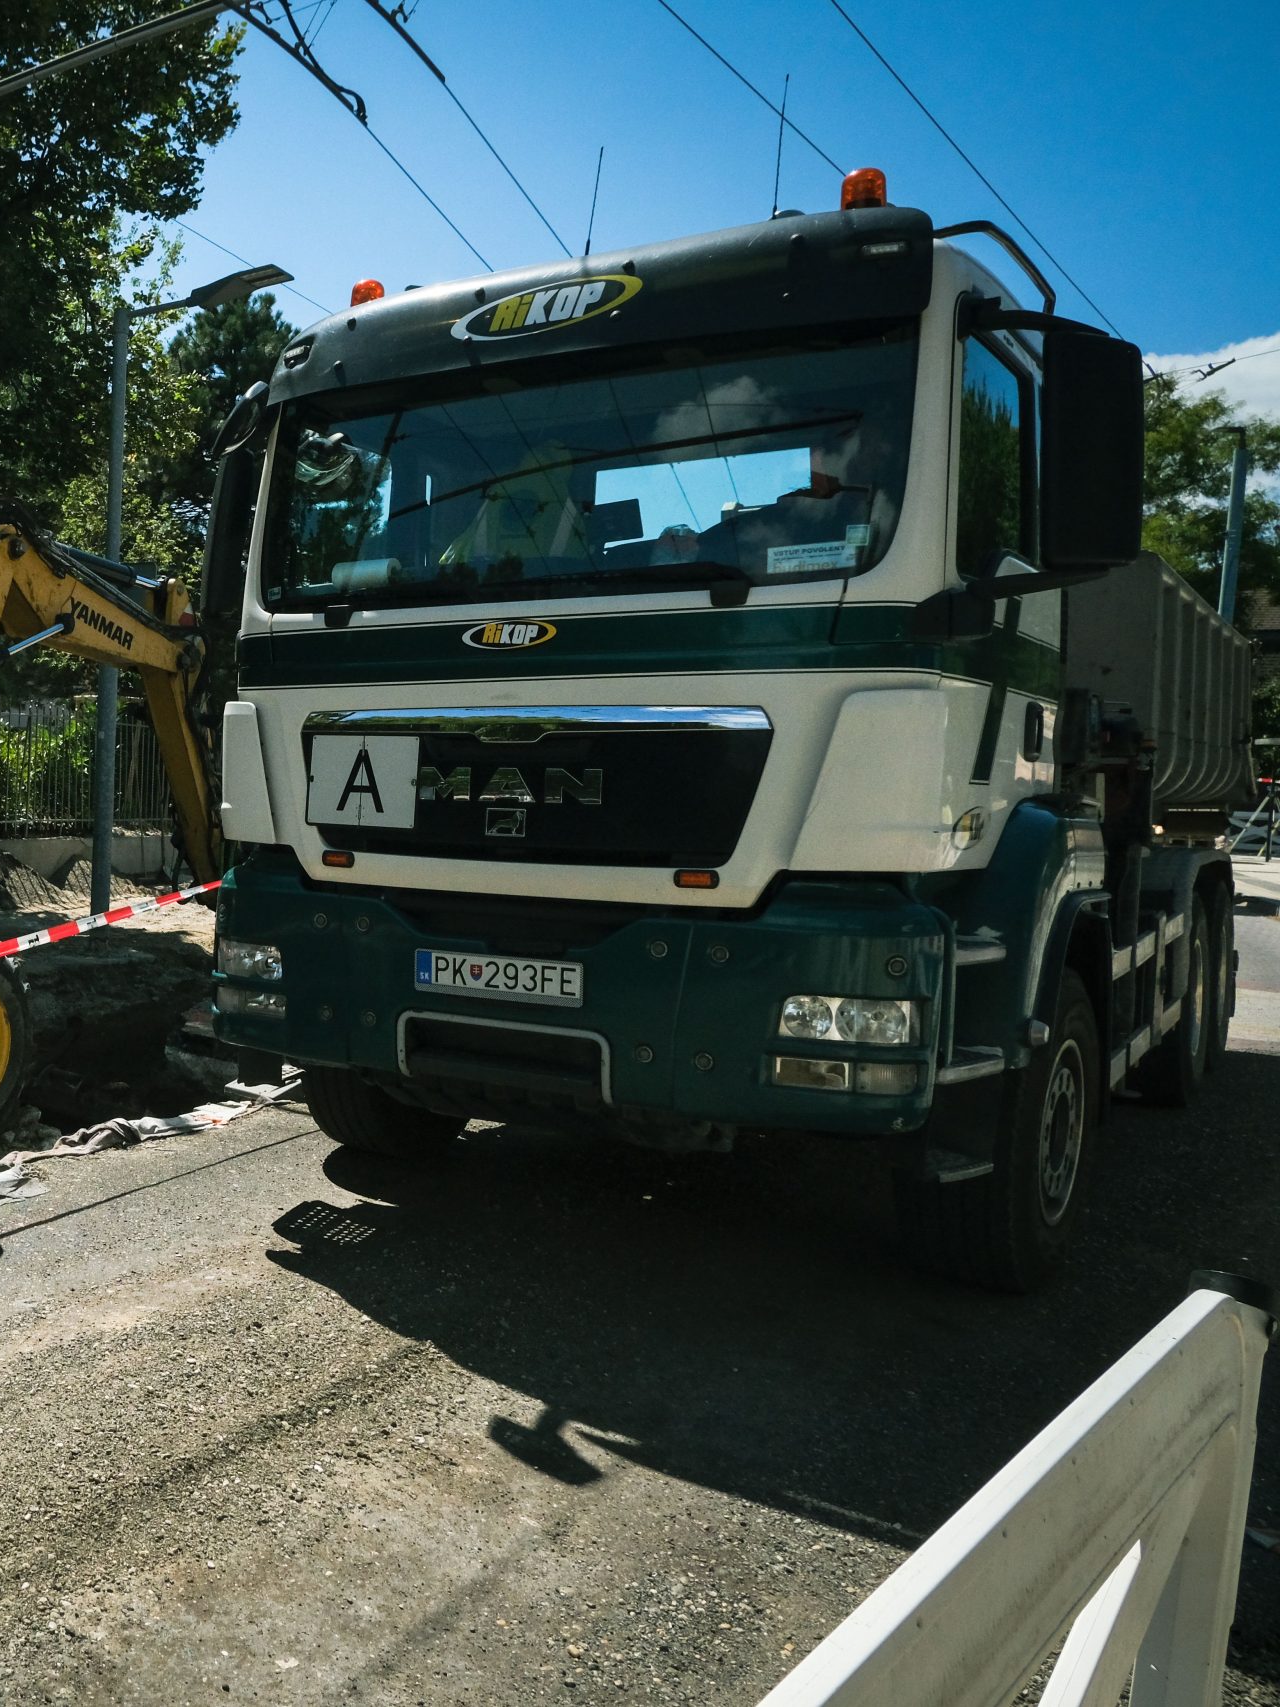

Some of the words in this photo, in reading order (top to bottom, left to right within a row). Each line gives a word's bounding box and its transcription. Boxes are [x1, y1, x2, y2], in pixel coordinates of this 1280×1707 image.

[70, 597, 134, 651] YANMAR
[335, 749, 385, 813] A
[419, 766, 603, 804] MAN
[419, 971, 430, 981] SK
[434, 955, 468, 986] PK
[484, 961, 577, 997] 293FE
